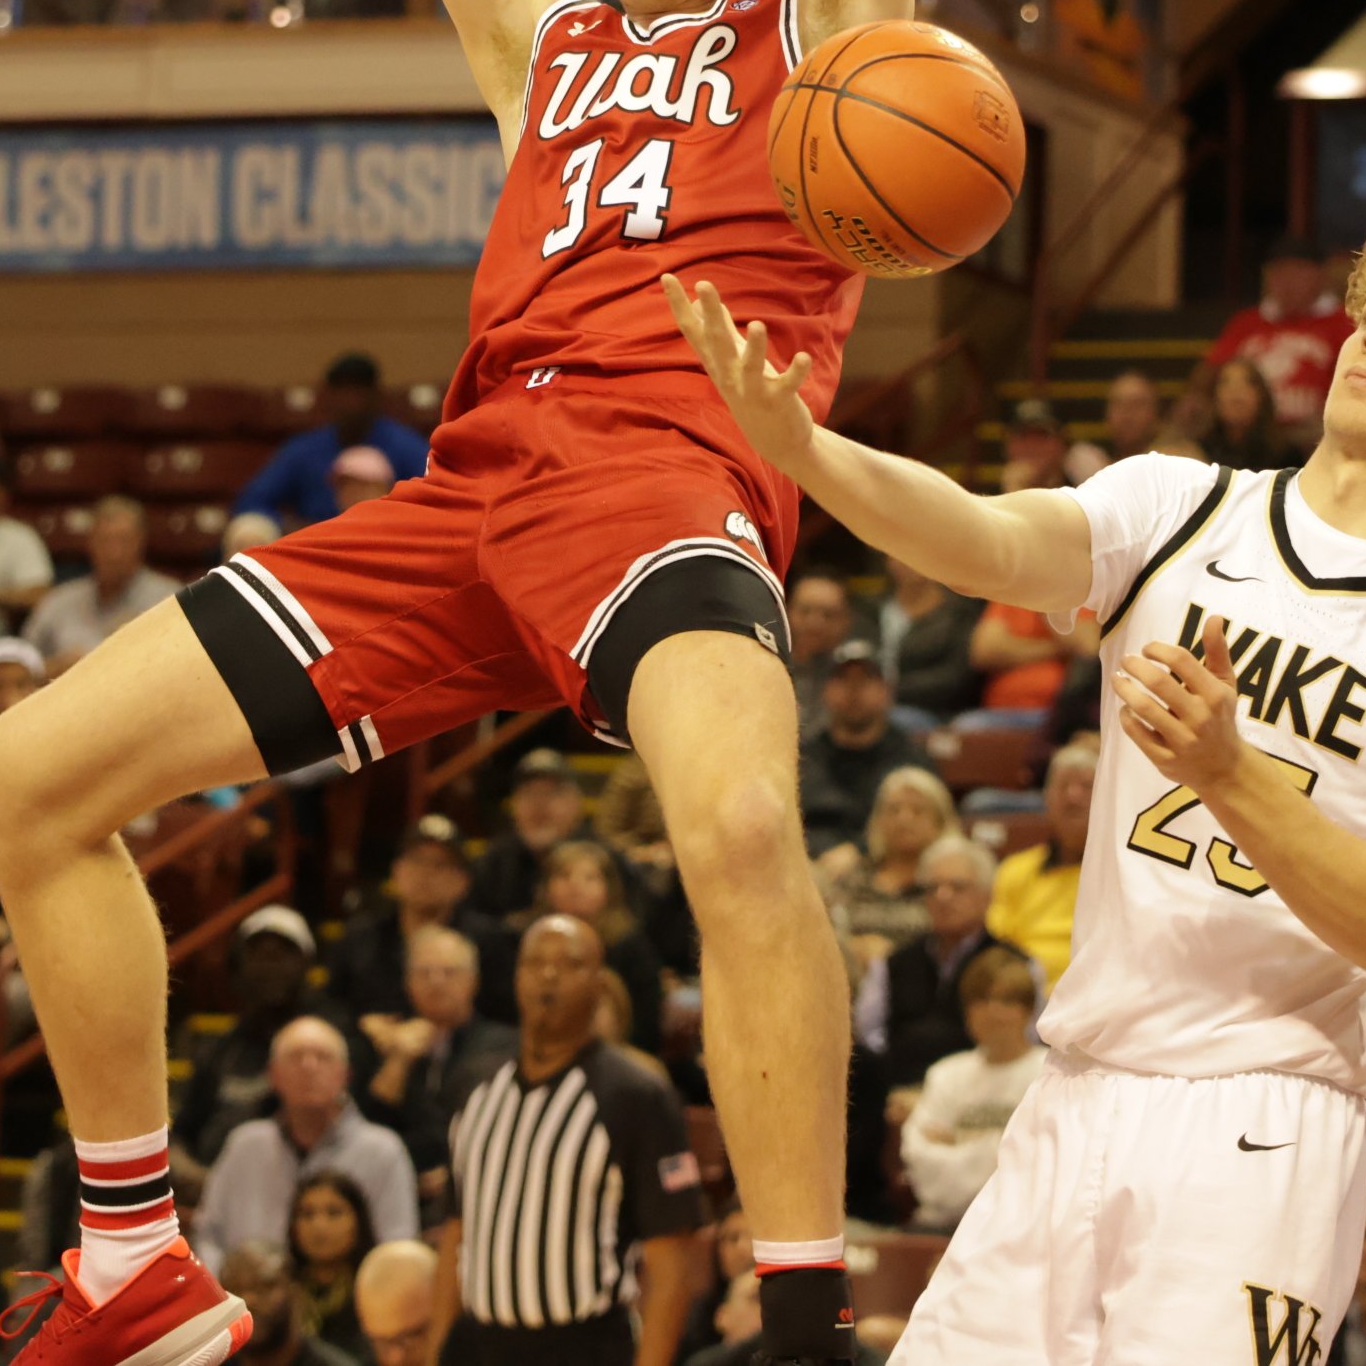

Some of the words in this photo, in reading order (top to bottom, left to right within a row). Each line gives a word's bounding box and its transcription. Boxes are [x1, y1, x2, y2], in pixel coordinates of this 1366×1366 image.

[537, 20, 742, 142] Uah
[235, 141, 509, 249] CLASSIC
[540, 136, 676, 261] 34
